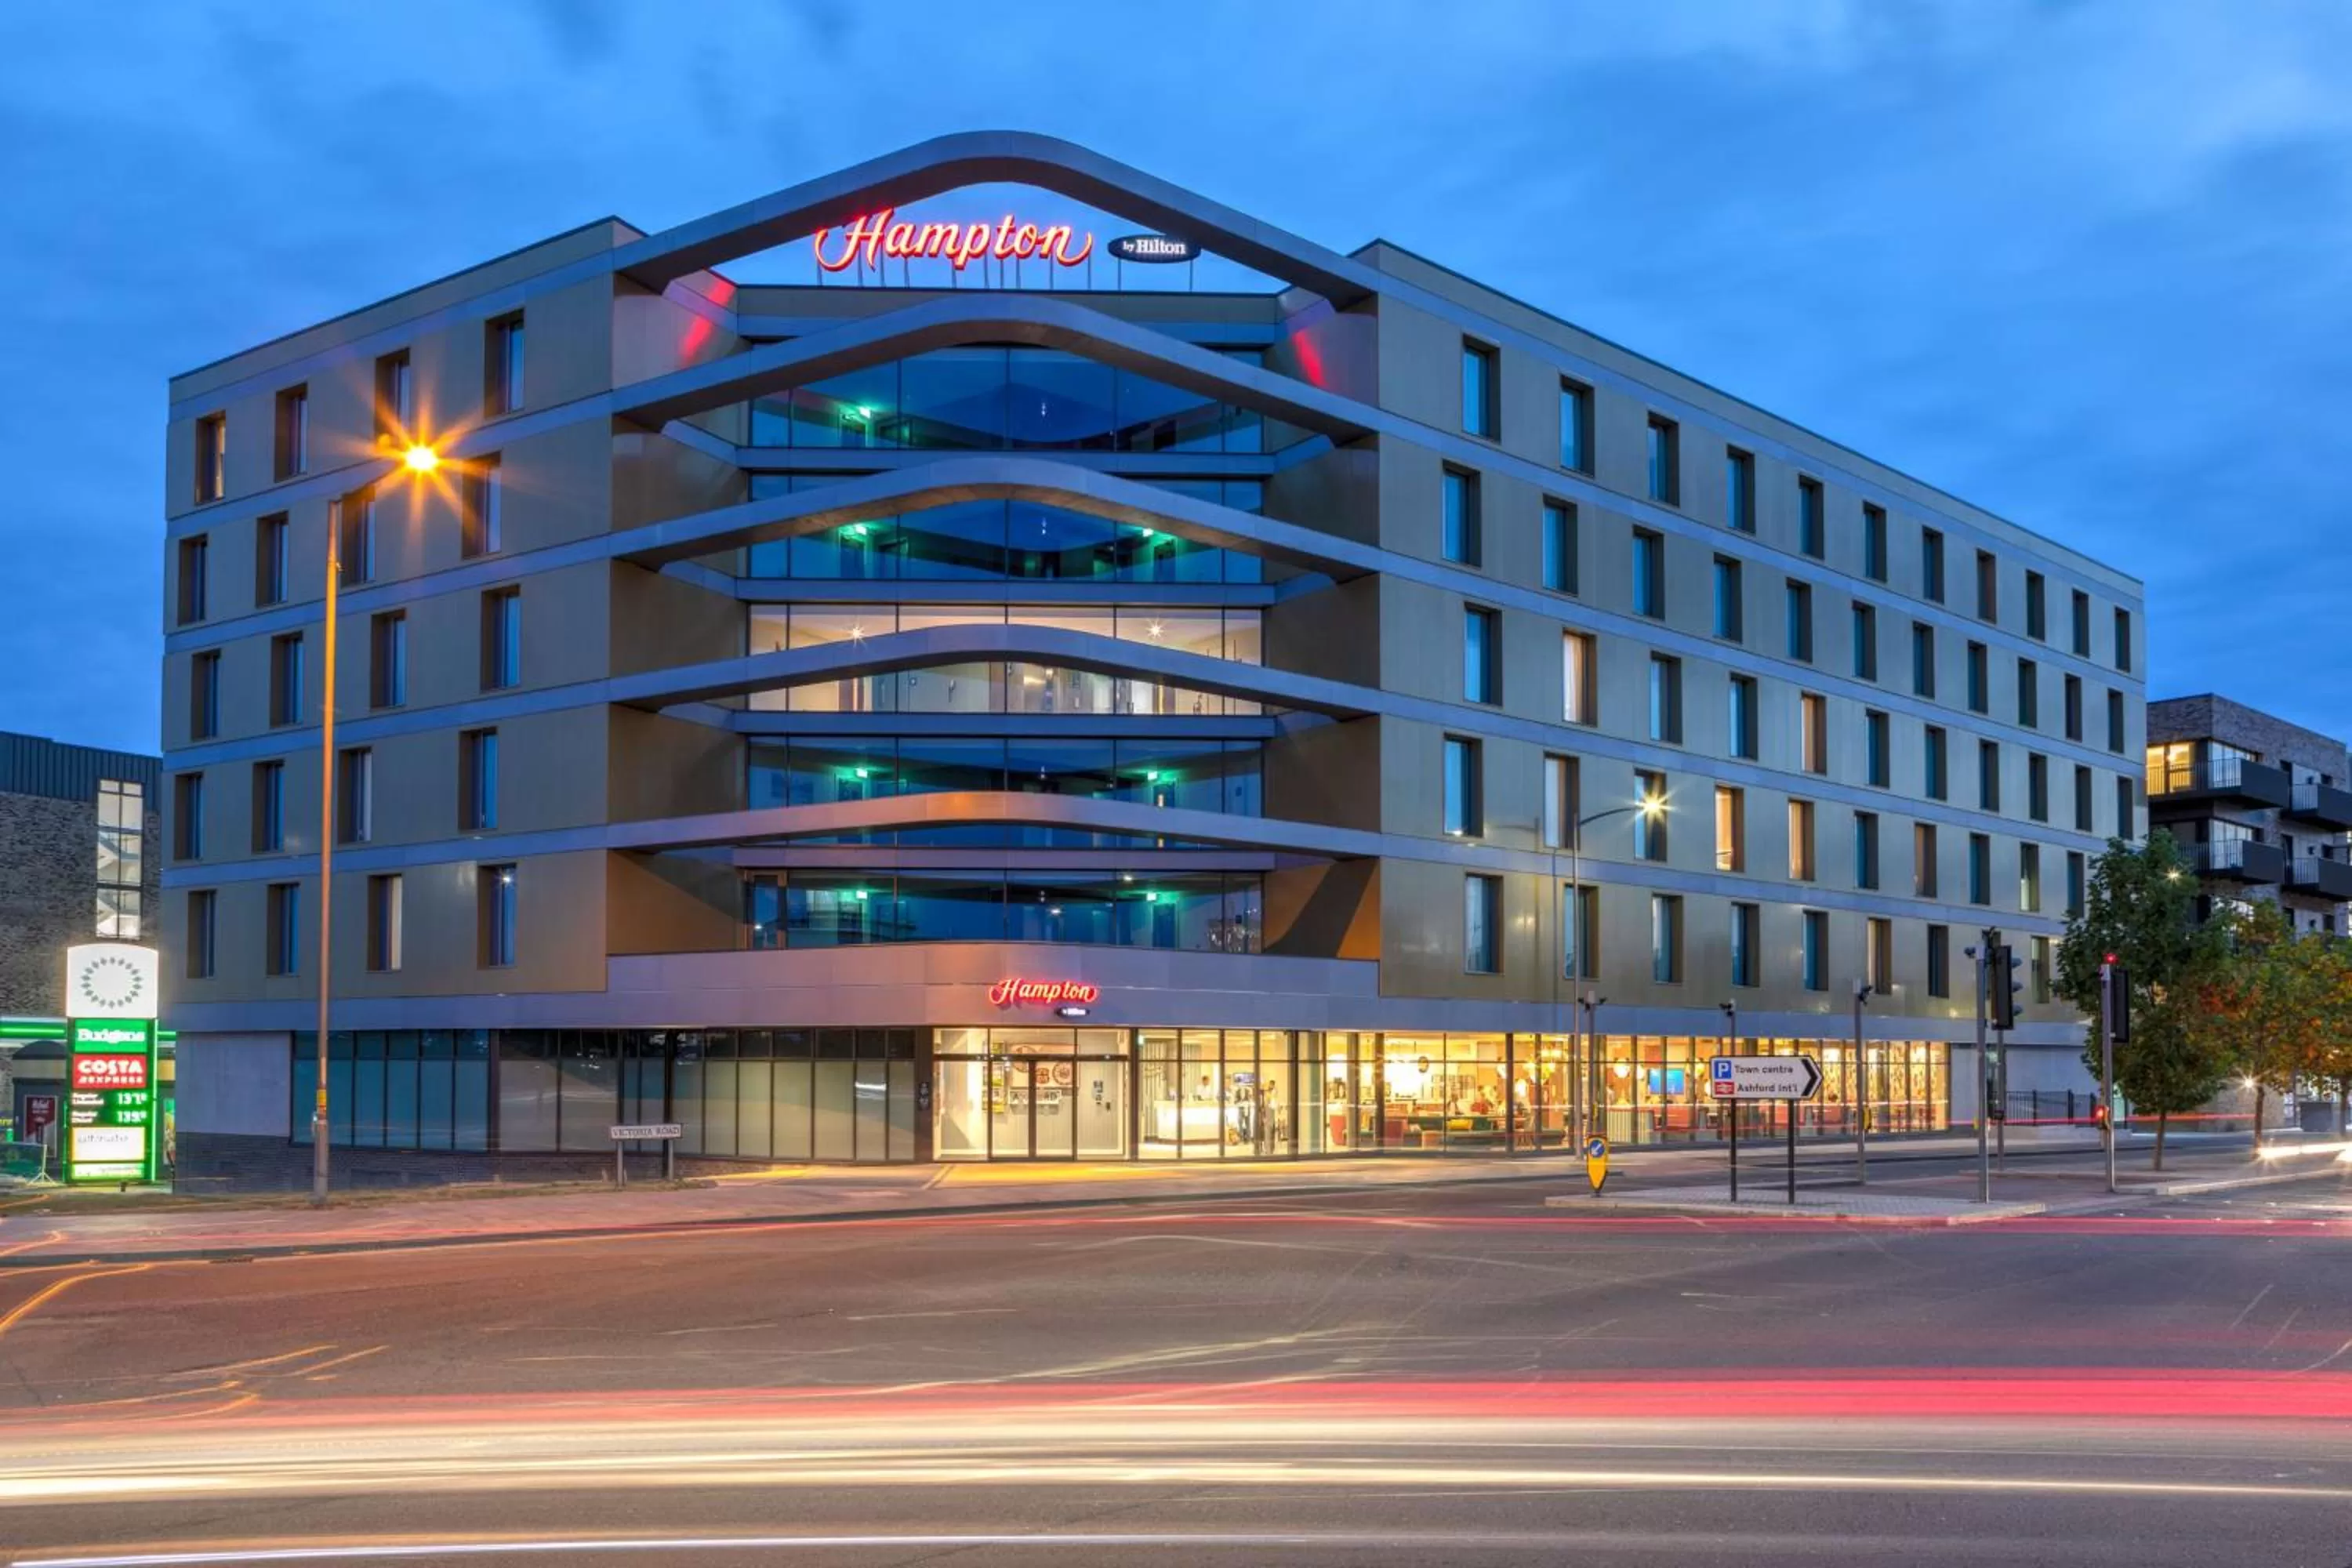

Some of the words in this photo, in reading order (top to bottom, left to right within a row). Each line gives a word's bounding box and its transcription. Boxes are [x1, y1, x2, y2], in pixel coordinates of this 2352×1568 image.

[814, 206, 1093, 273] Hampton
[1122, 240, 1134, 252] by
[1136, 238, 1186, 254] Hilton
[988, 978, 1100, 1004] Hampton
[78, 1059, 143, 1075] COSTA
[1734, 1064, 1760, 1074] Town
[1762, 1065, 1794, 1074] centre
[1737, 1082, 1776, 1092] Ashford
